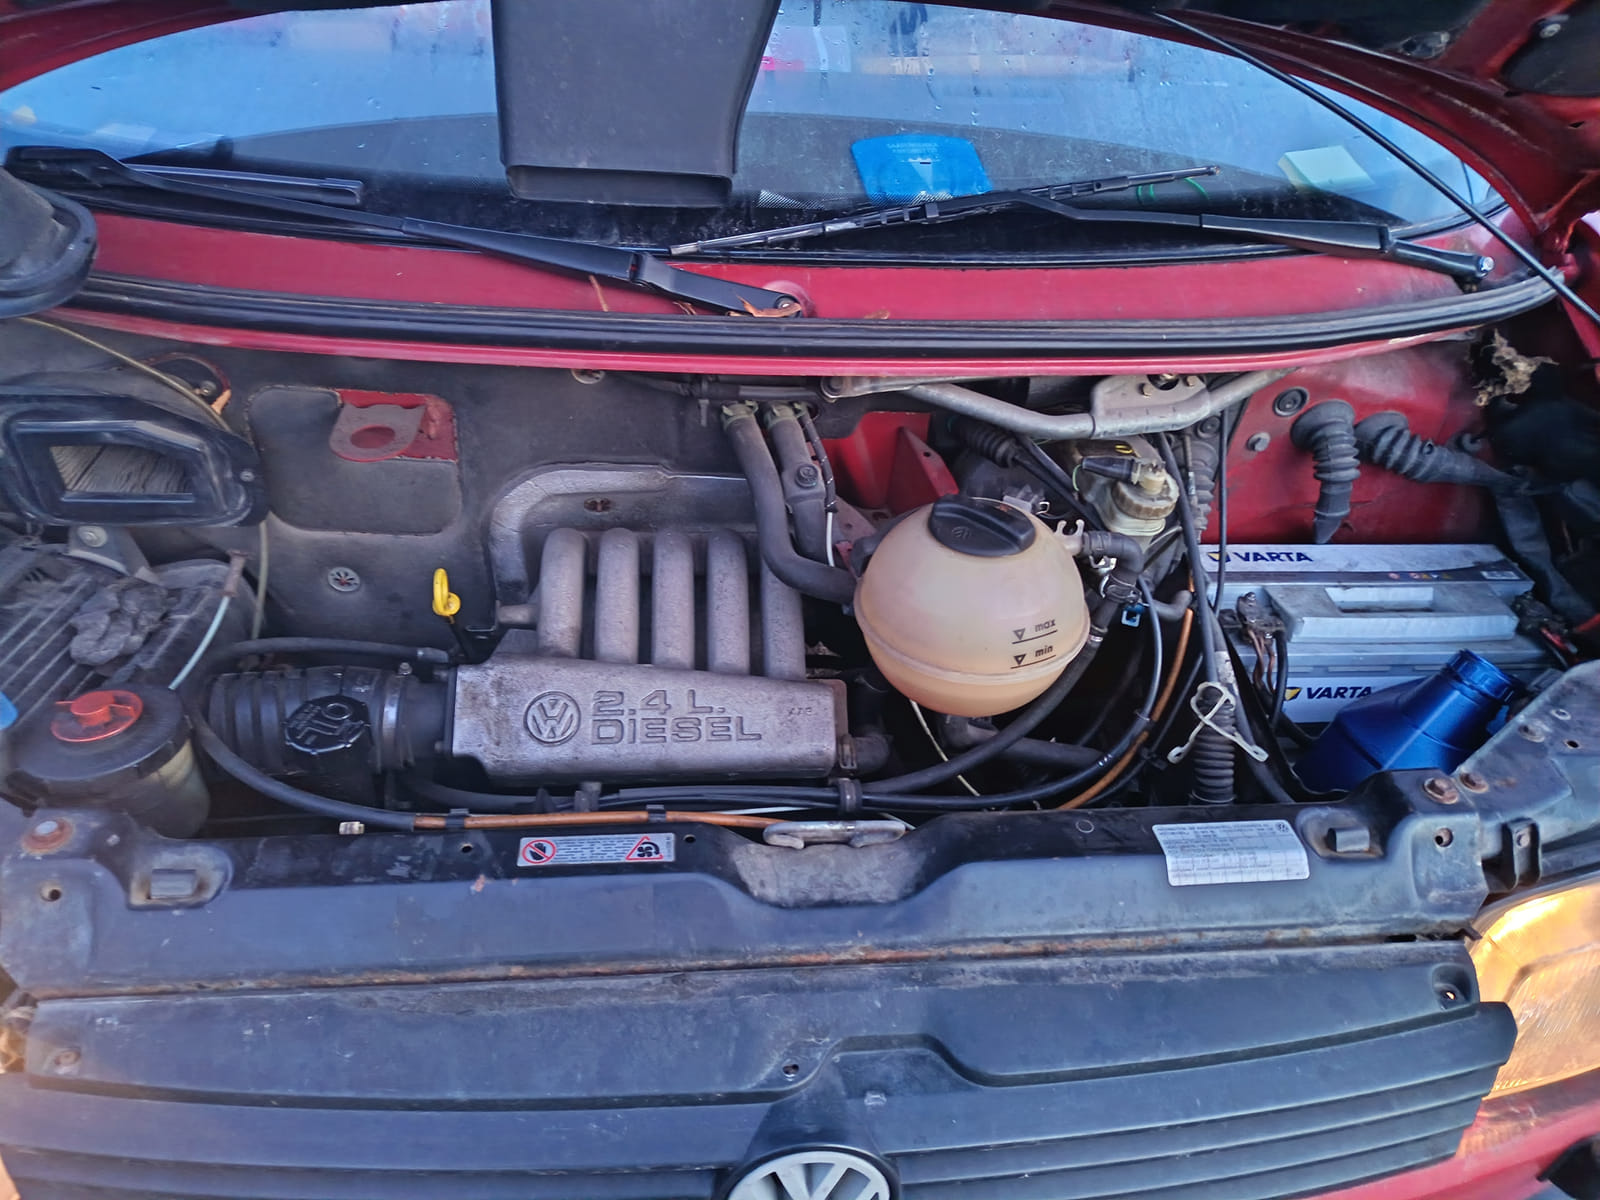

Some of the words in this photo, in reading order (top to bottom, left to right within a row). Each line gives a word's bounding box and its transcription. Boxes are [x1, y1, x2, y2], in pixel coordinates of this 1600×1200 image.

[1232, 551, 1314, 562] VARTA
[1034, 619, 1057, 632] max
[1034, 644, 1054, 657] min
[1306, 686, 1373, 699] VARTA
[592, 690, 672, 716] 2.4
[524, 691, 582, 745] VW
